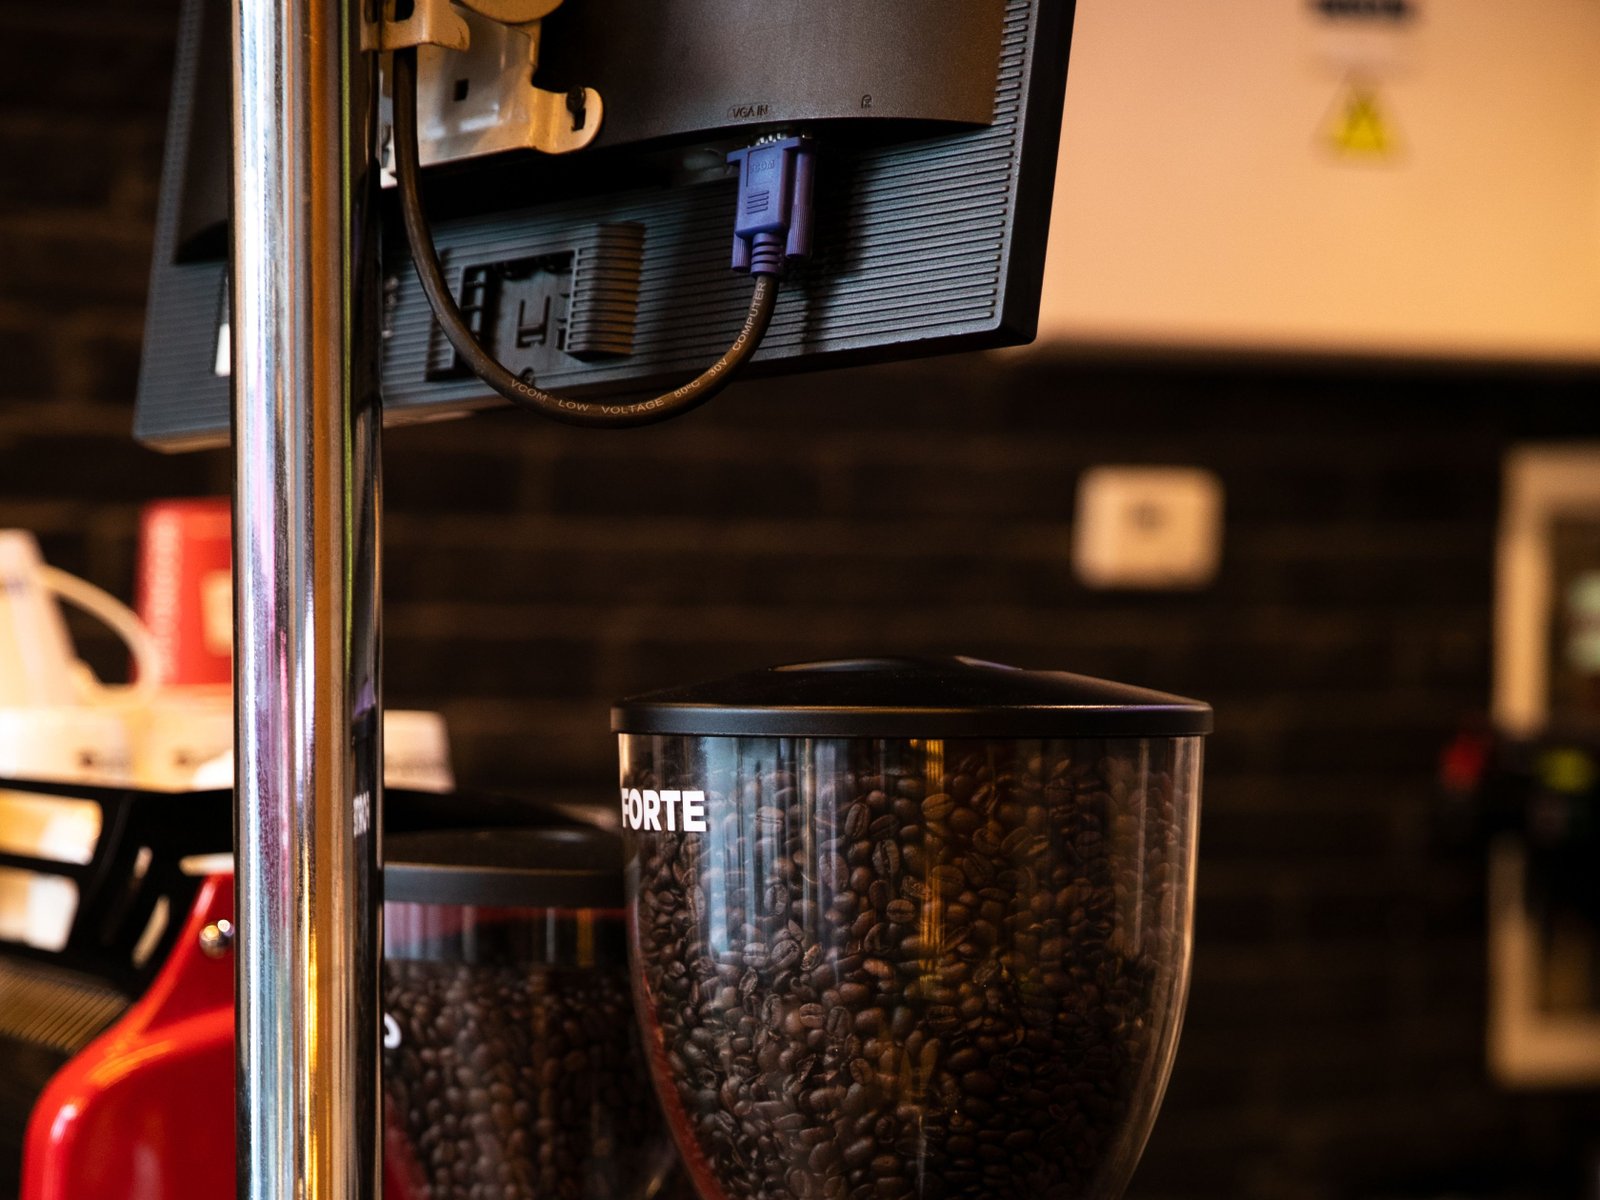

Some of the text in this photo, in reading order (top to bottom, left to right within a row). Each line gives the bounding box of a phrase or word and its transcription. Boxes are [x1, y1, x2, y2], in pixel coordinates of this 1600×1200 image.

[732, 103, 769, 119] VGA IN
[510, 378, 548, 402] VCOM
[558, 399, 589, 412] LOW
[601, 398, 665, 415] VOLTAGE
[732, 281, 767, 351] COMPUTER
[621, 788, 707, 832] FORTE
